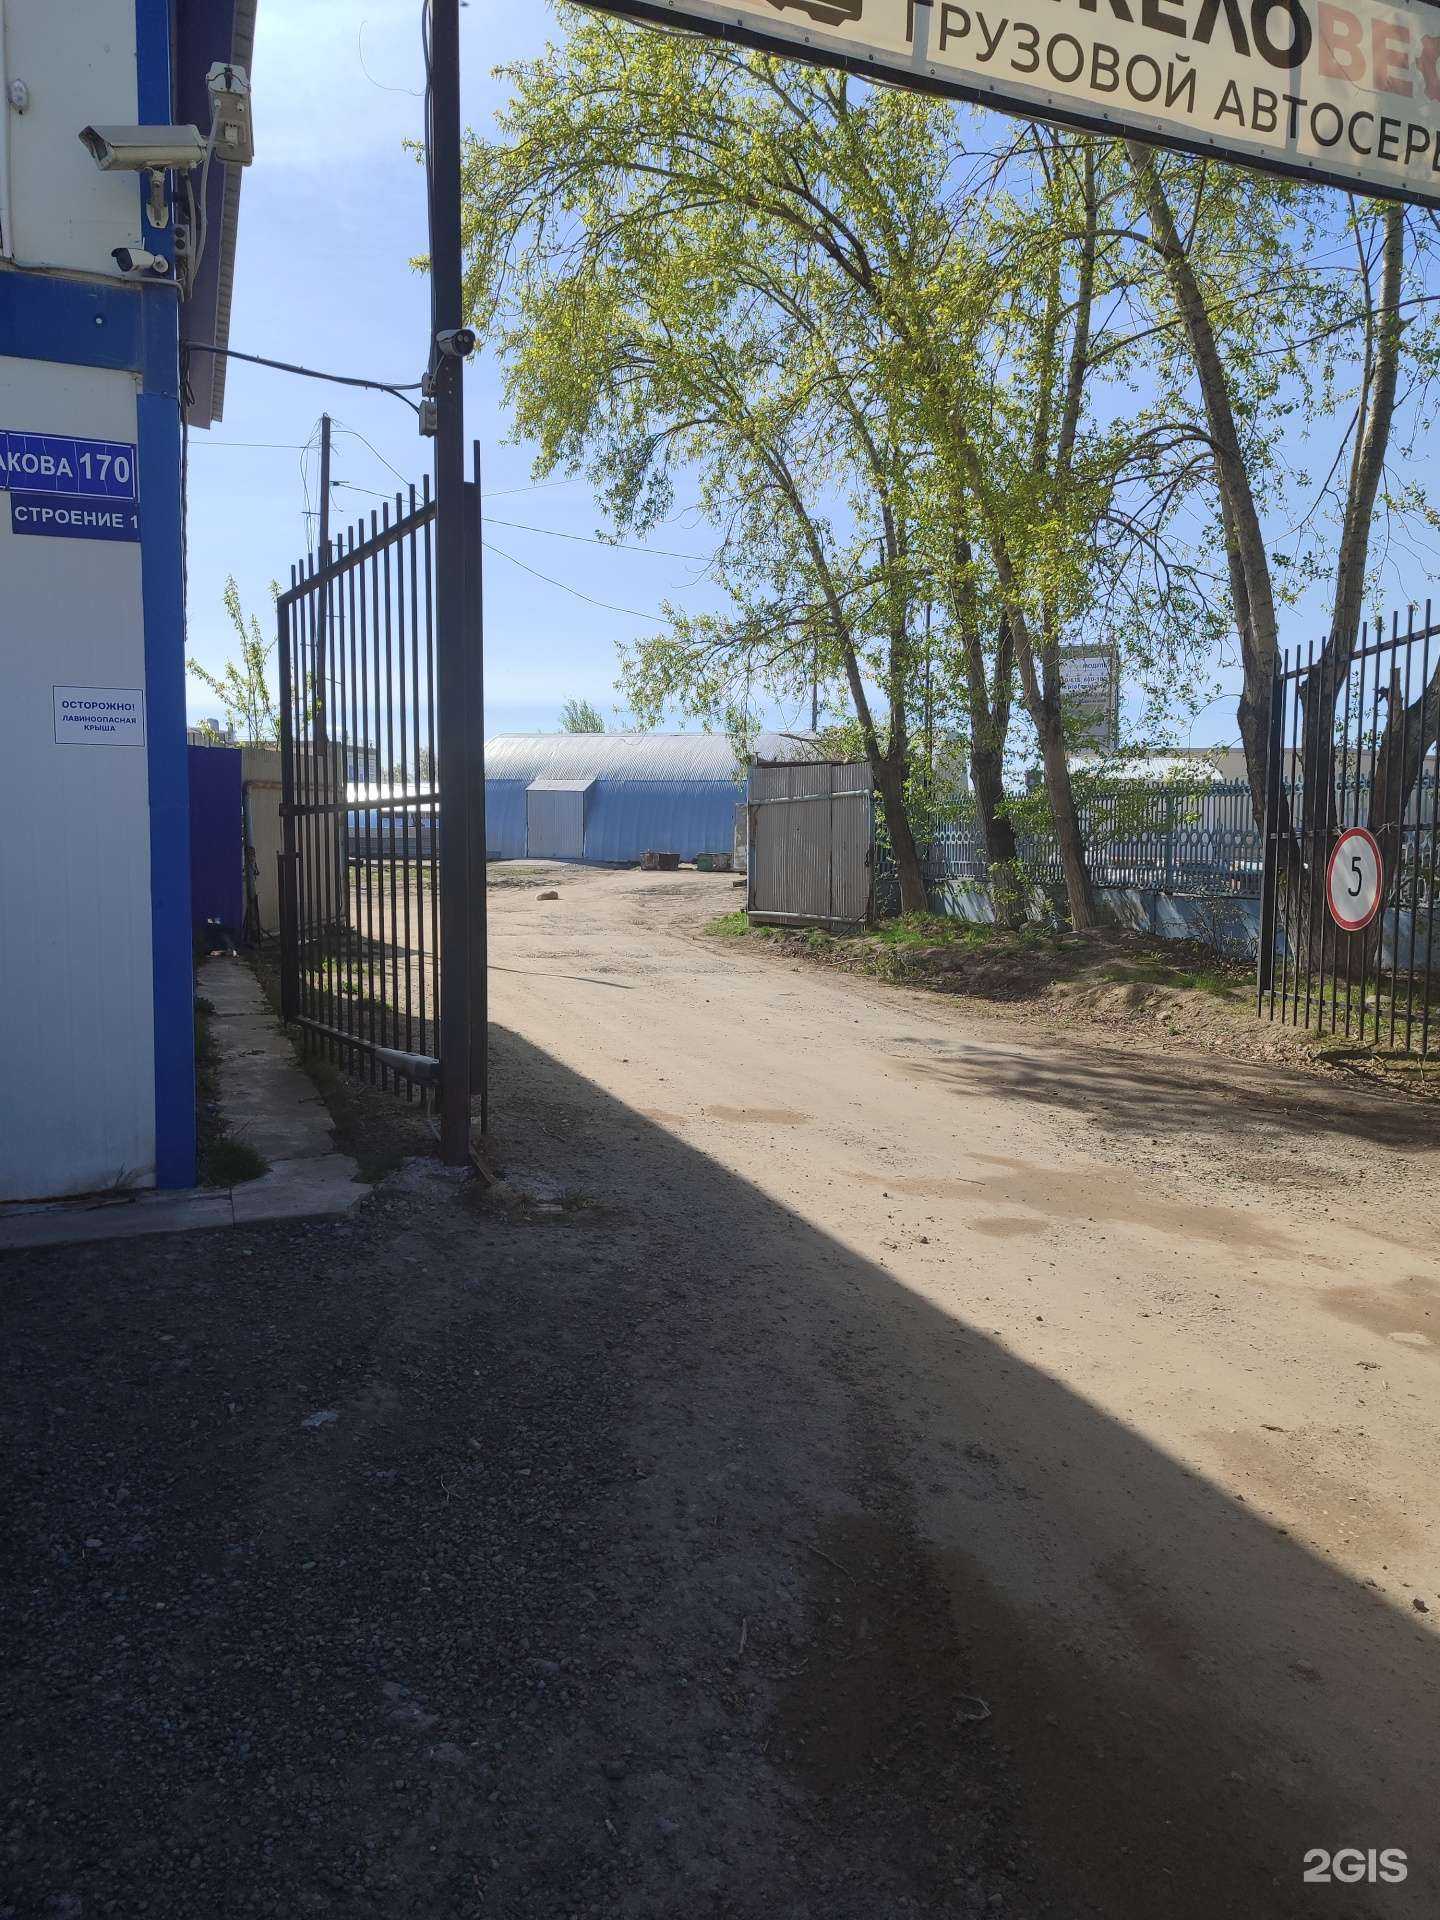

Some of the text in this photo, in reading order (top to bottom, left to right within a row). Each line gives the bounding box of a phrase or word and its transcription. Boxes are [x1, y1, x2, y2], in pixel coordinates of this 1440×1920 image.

[905, 0, 1196, 114] ГРУЗОВОЙ
[1048, 0, 1440, 102] ЛОВЕ
[79, 452, 130, 483] 170
[14, 506, 138, 529] СТРОЕНИЕ 1
[62, 700, 135, 712] ОСТОРОЖНО!
[62, 714, 137, 724] ЛАВИНООПАСНАЯ
[84, 724, 116, 732] КРЫША
[1348, 856, 1363, 897] 5
